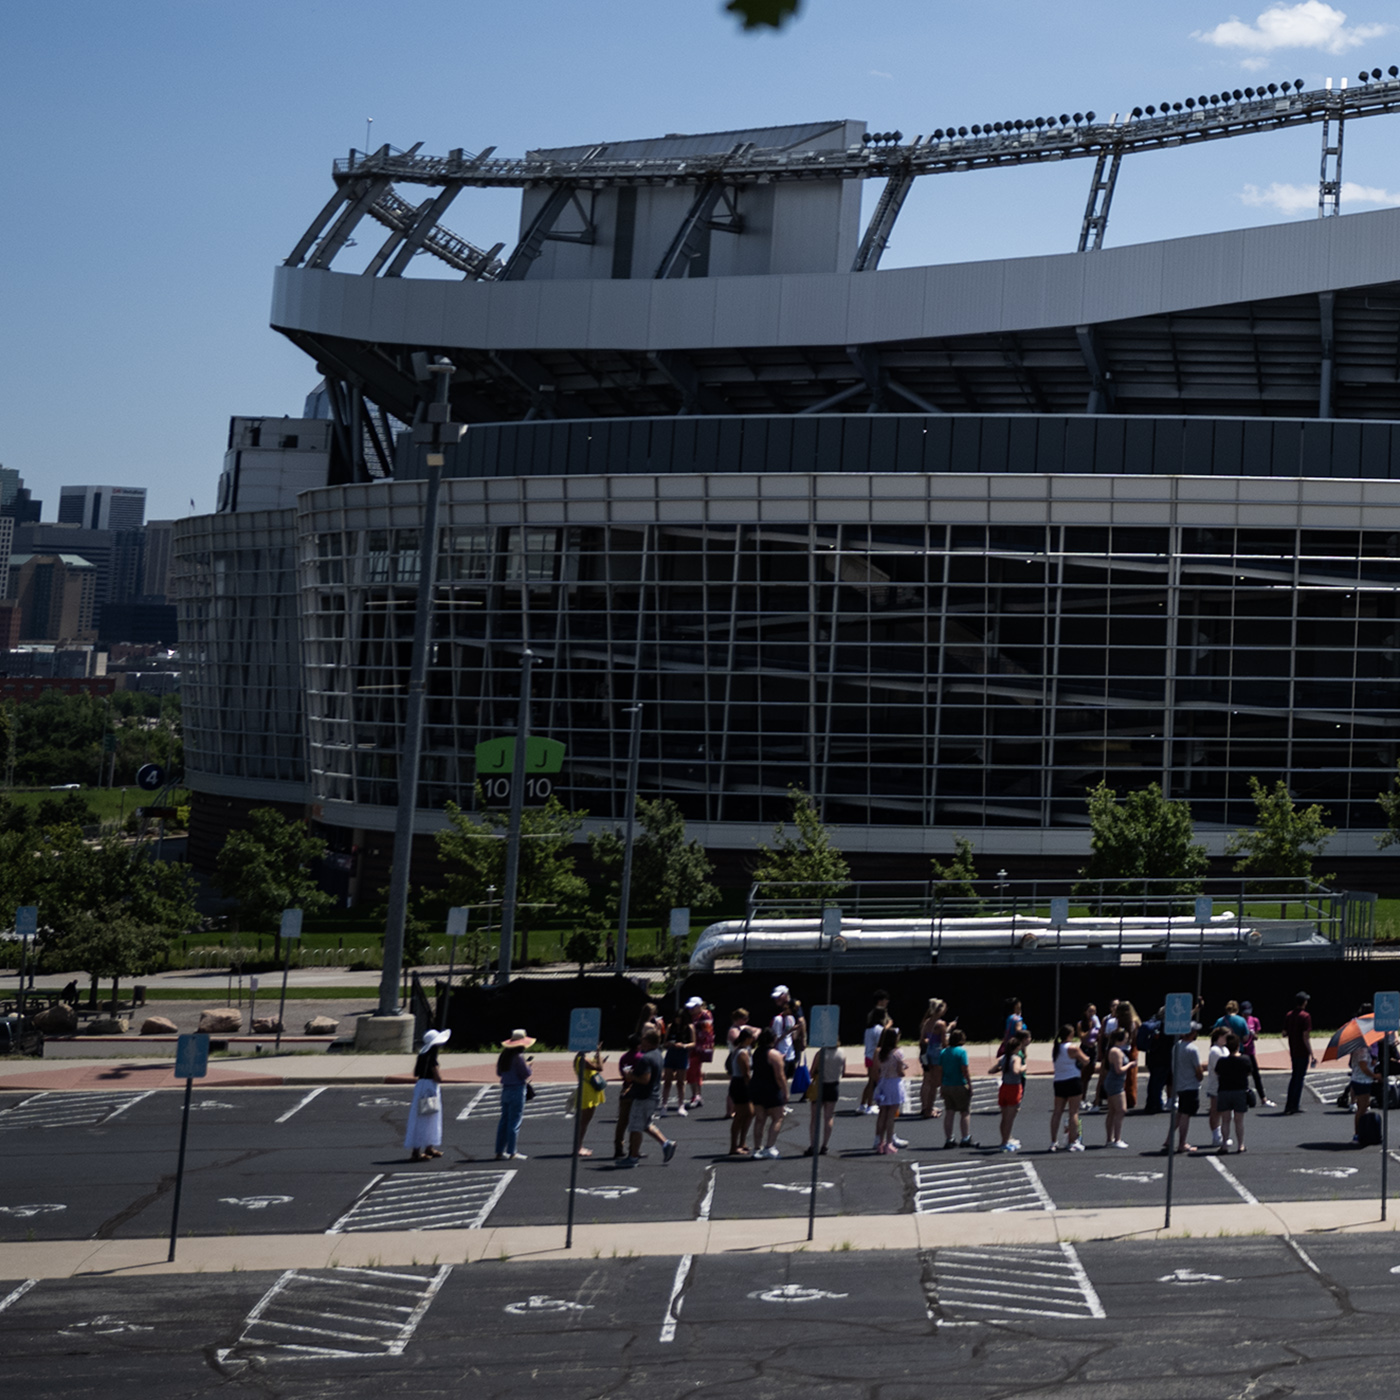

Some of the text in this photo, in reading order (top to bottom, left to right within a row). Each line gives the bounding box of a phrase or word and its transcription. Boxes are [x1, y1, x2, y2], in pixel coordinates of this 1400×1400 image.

[493, 749, 506, 768] J
[536, 749, 549, 768] J
[143, 769, 159, 785] 4
[485, 777, 510, 800] 10
[526, 777, 551, 800] 10
